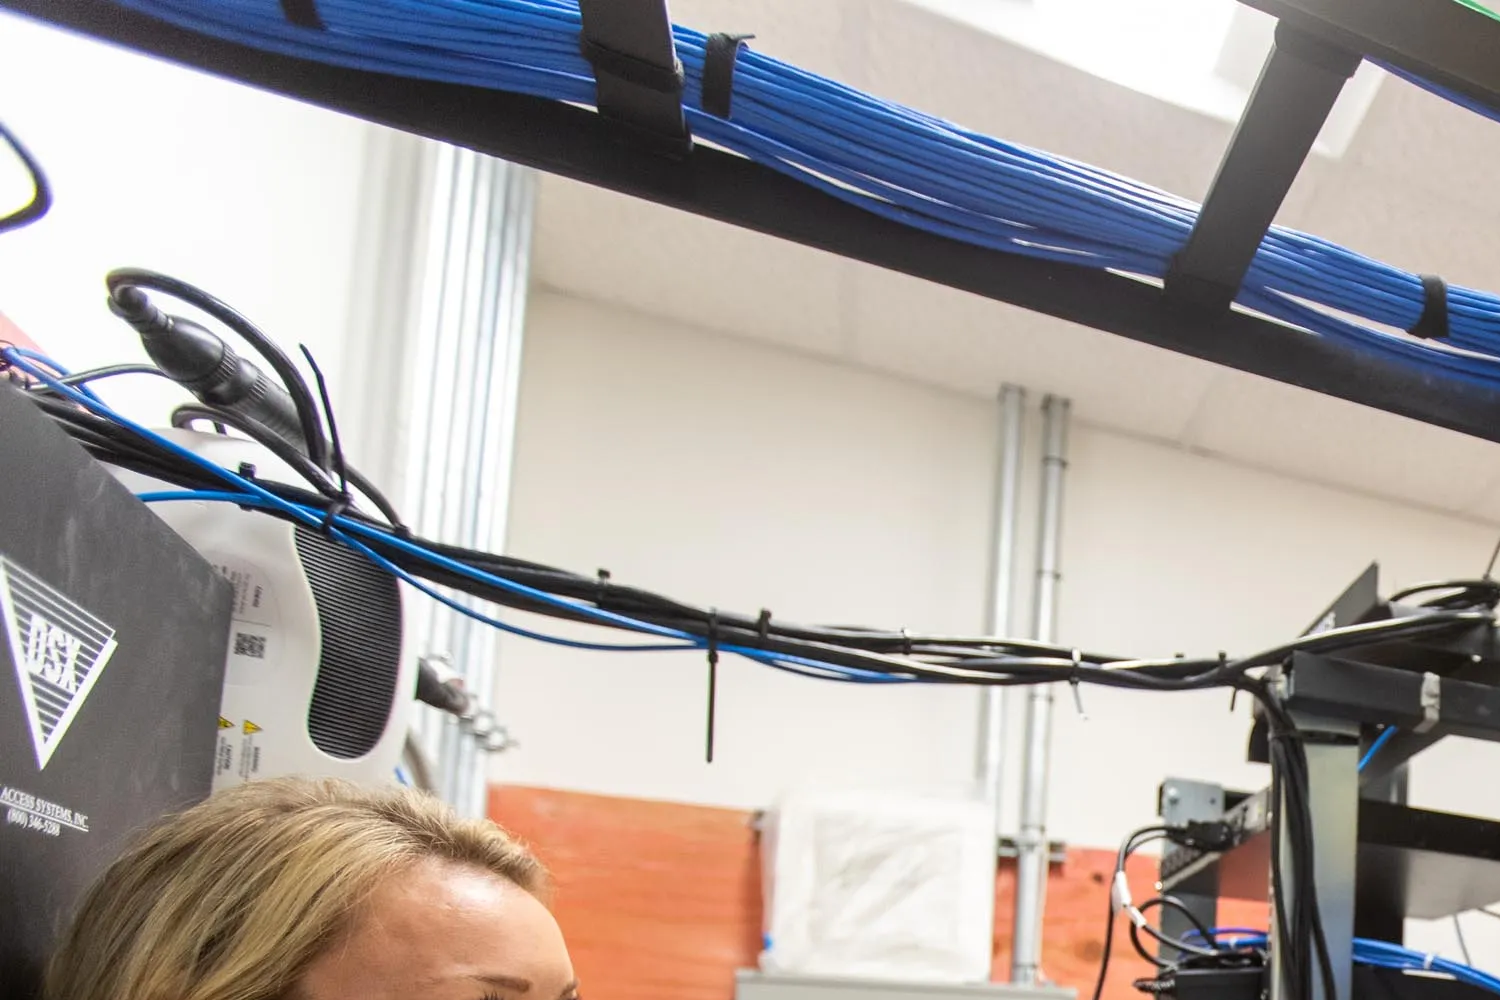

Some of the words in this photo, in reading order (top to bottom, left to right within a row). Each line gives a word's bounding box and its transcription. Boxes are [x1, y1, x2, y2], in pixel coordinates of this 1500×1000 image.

[26, 612, 81, 695] DSX
[0, 786, 36, 810] ACCESS
[35, 797, 73, 824] SYSTEMS,
[73, 811, 89, 829] INC.
